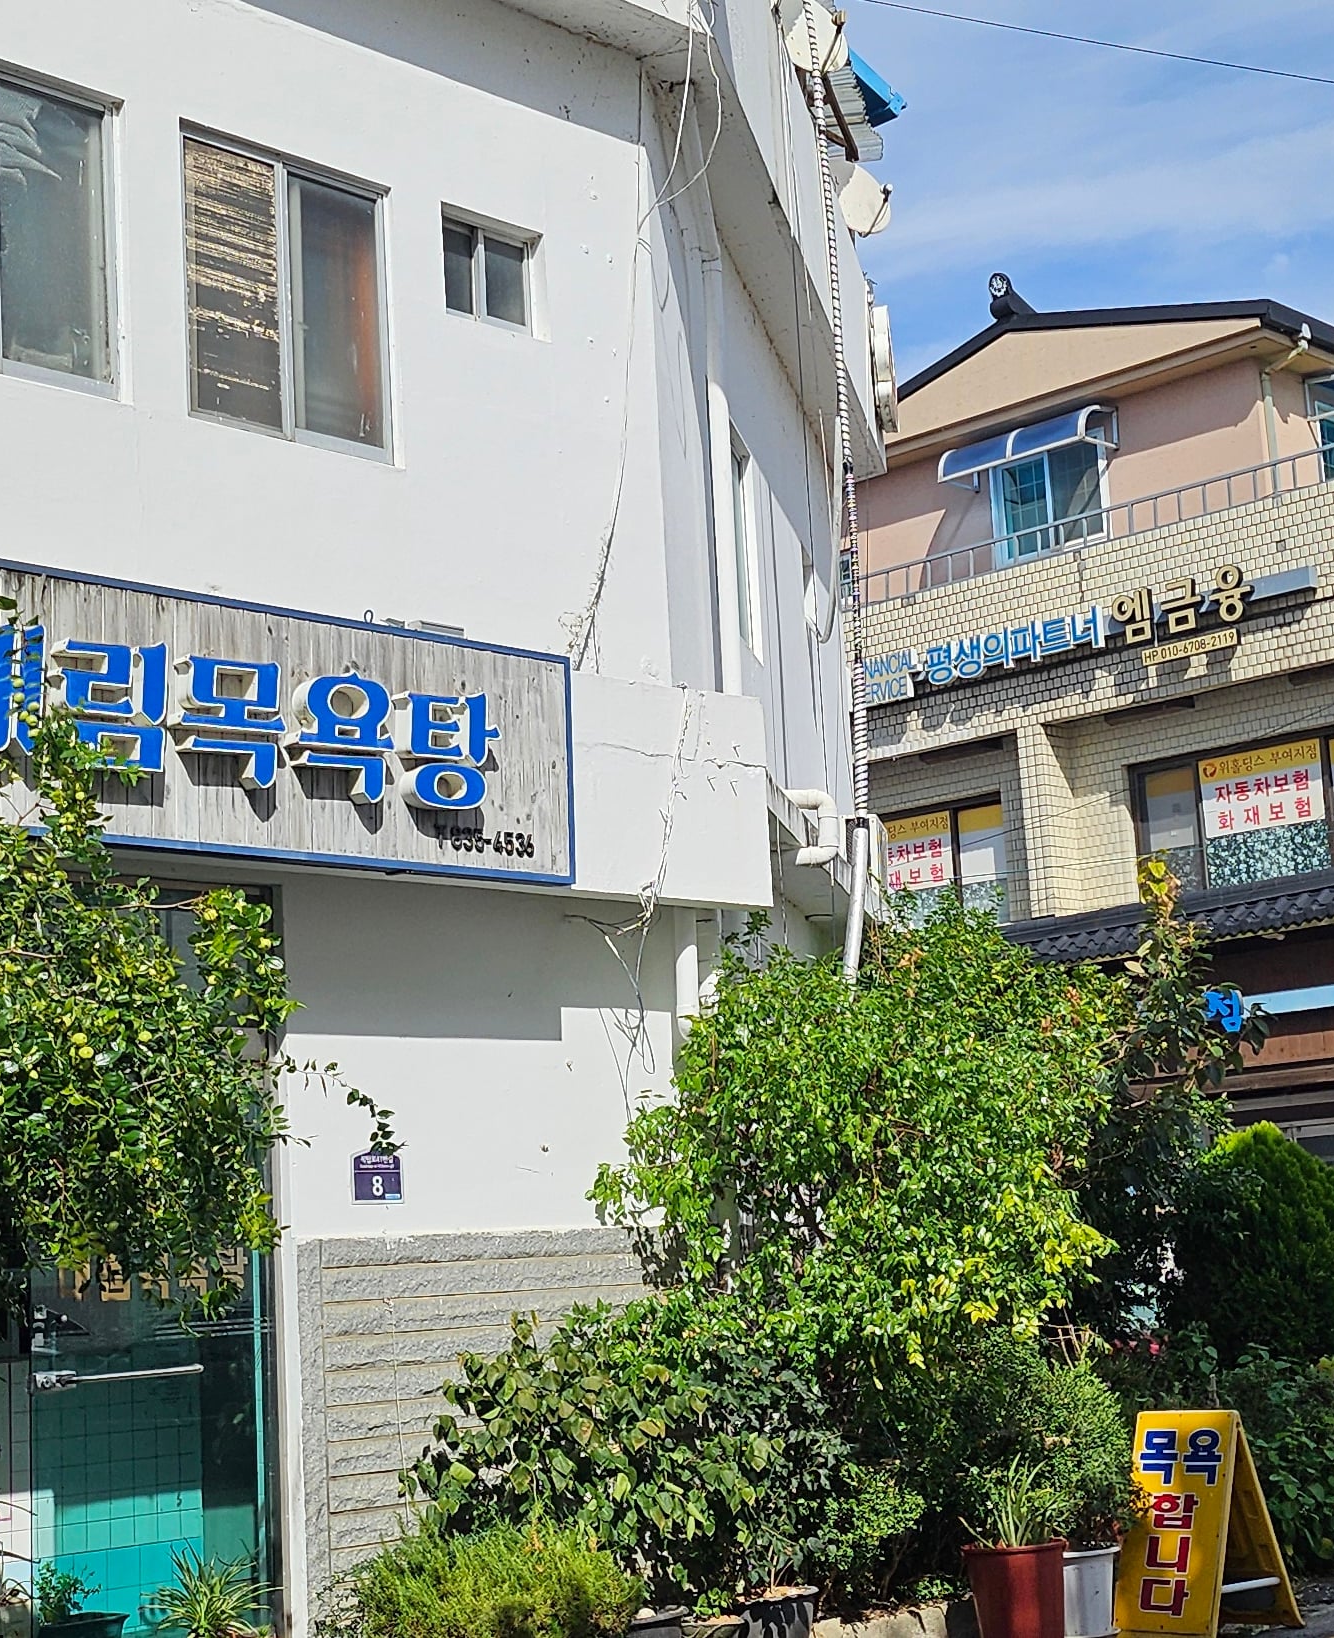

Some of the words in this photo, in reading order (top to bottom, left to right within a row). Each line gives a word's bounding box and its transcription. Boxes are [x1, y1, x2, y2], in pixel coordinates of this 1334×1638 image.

[1111, 564, 1254, 645] 엠금융
[1143, 650, 1159, 664] HP
[1161, 632, 1236, 659] 010-6708-2119
[864, 648, 915, 679] NANCIAL
[865, 676, 907, 704] ERVICE
[1269, 743, 1318, 765] 부여지점
[1214, 768, 1310, 804] 자동차보험
[888, 824, 907, 840] 딩스
[888, 838, 943, 866] 차보험
[888, 862, 944, 889] 재보험
[372, 1175, 384, 1197] 8
[1139, 1429, 1224, 1486] 목욕
[1139, 1492, 1201, 1618] 합니다
